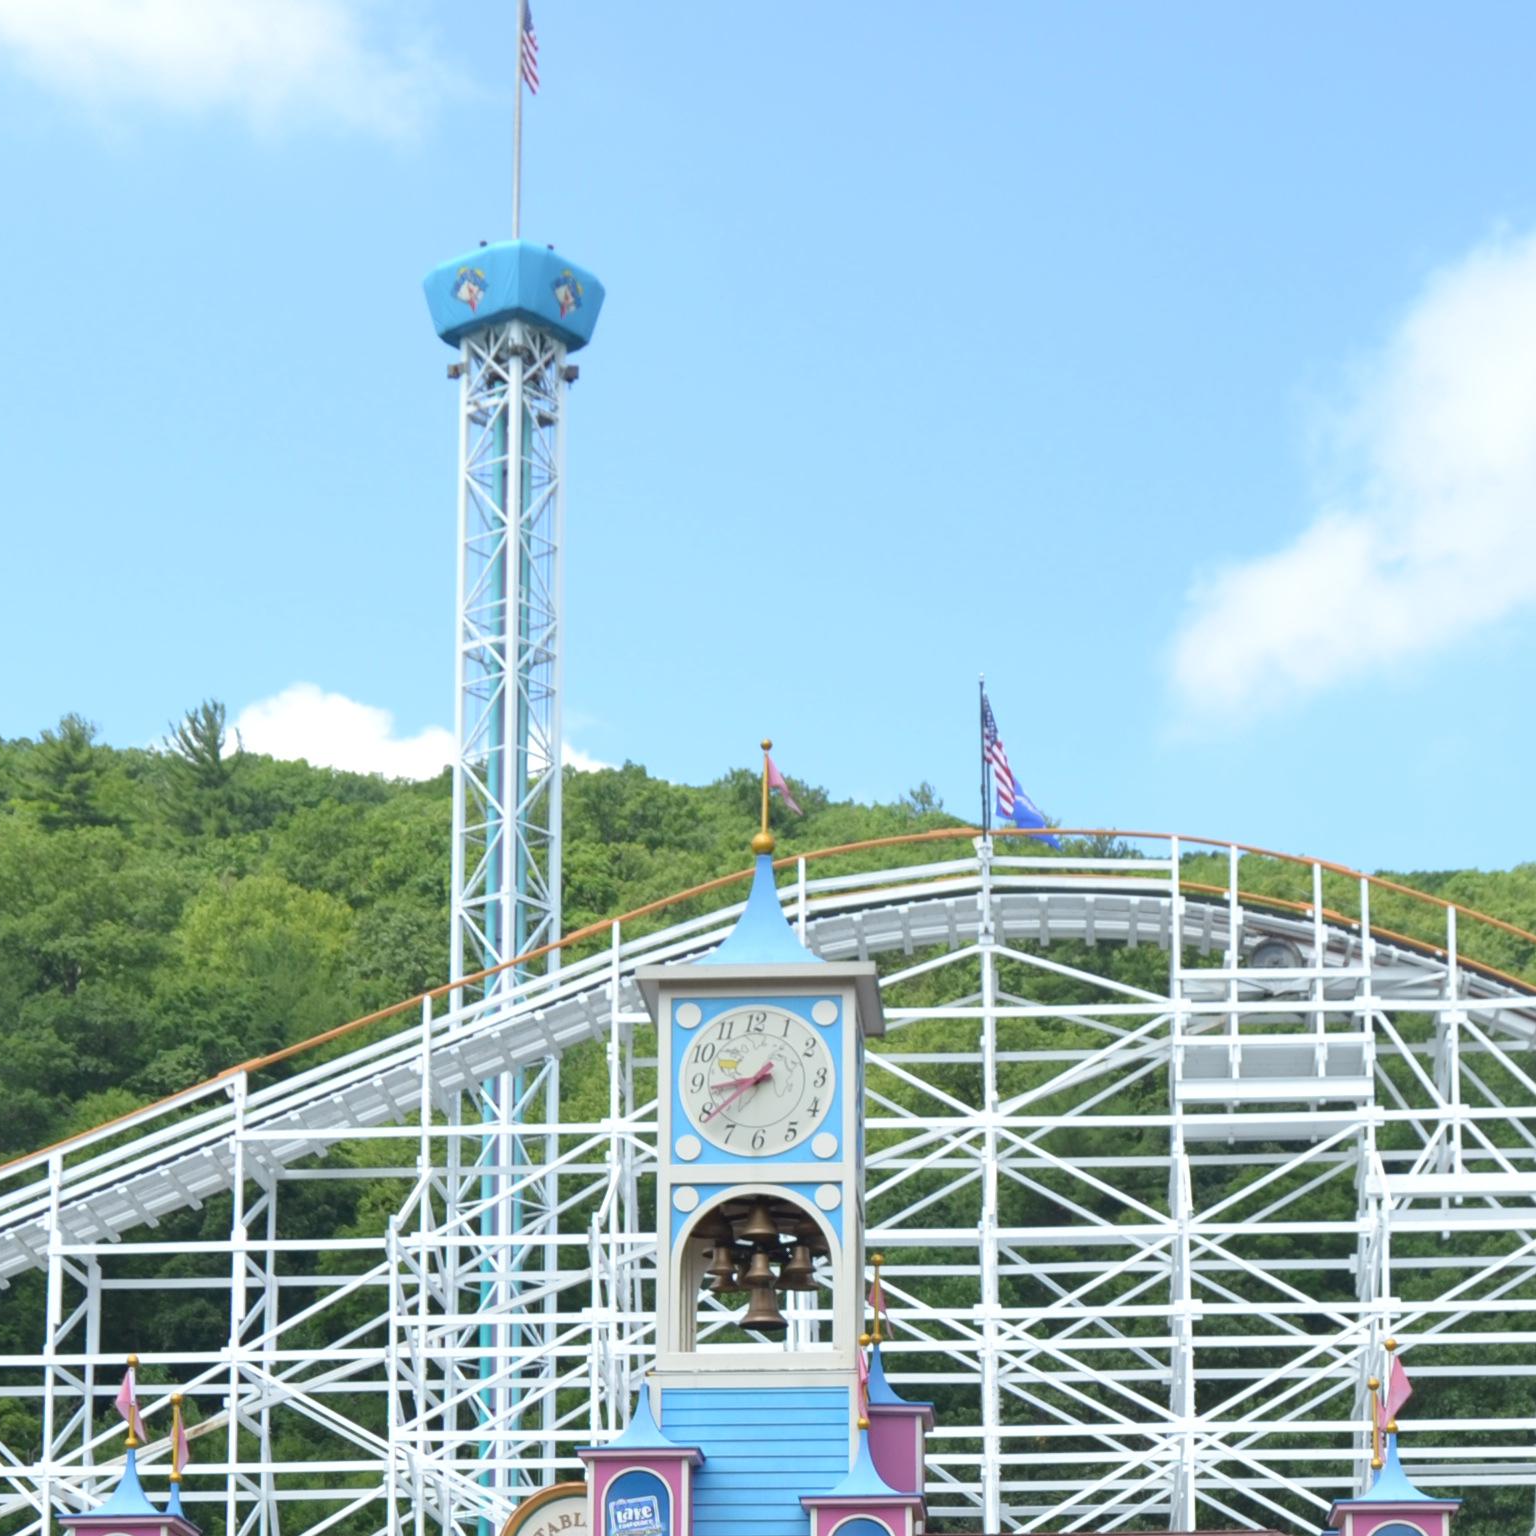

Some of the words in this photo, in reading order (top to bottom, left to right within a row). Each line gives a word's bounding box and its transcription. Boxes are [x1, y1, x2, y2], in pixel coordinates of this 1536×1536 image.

[717, 1021, 734, 1040] 11
[745, 1011, 767, 1033] 12
[782, 1018, 791, 1038] 1
[693, 1043, 715, 1064] 10
[803, 1037, 816, 1058] 2
[690, 1073, 704, 1094] 9
[813, 1067, 827, 1088] 3
[698, 1102, 713, 1123] 8
[806, 1096, 819, 1118] 4
[723, 1124, 737, 1145] 7
[751, 1129, 766, 1150] 6
[784, 1121, 799, 1142] 5
